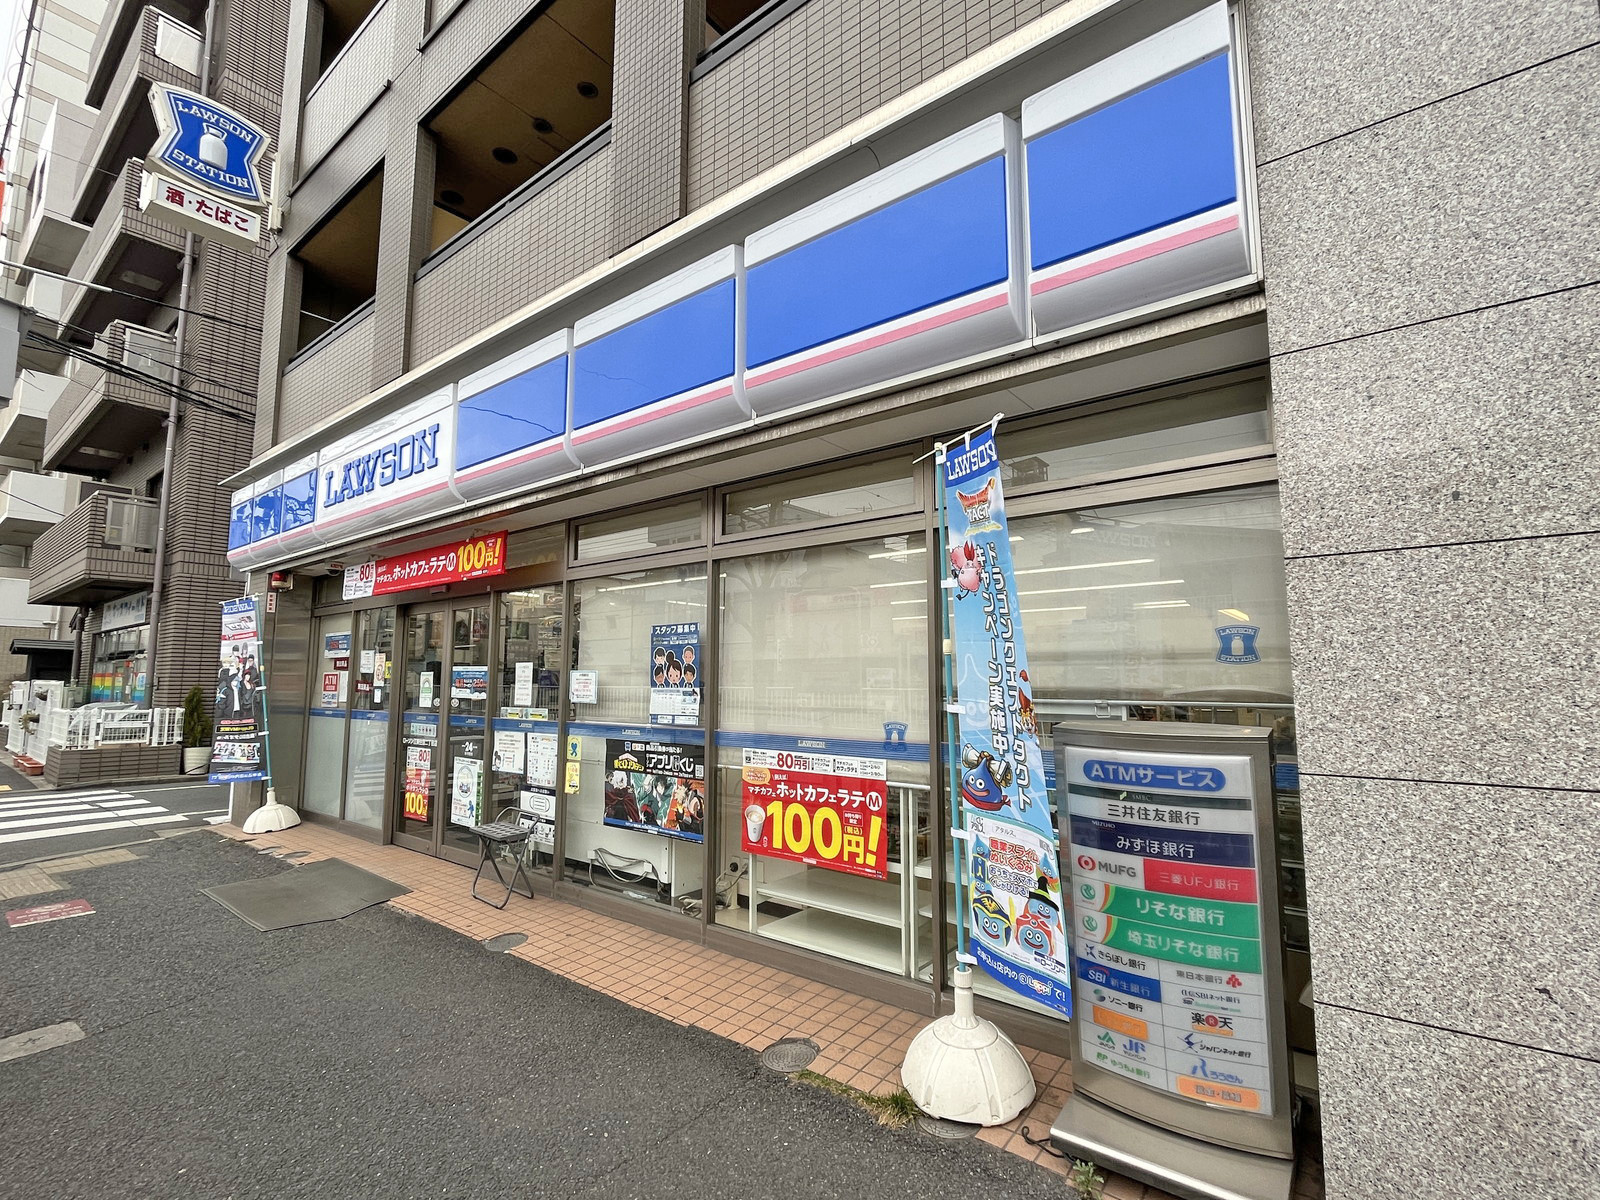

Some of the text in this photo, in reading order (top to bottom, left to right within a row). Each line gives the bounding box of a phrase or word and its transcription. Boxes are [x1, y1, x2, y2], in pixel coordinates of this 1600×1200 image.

[176, 101, 253, 143] LAWSON
[172, 149, 250, 188] STATION
[166, 186, 248, 232] 酒・たばこ
[323, 423, 440, 508] LAWSON
[946, 439, 998, 481] LAWSON
[655, 625, 696, 635] スタッフ募集中
[797, 739, 826, 748] LAWSON
[777, 752, 810, 771] 80円引
[1090, 763, 1217, 789] ATMサービス
[1107, 803, 1201, 826] 三井住友銀行
[766, 800, 882, 867] 100円!
[1116, 834, 1195, 859] みずほ銀行
[989, 851, 1034, 874] ぬいぐるみ
[1098, 860, 1137, 878] MUFG
[1159, 872, 1240, 891] 三菱UFJ銀行
[1136, 897, 1225, 927] りそな銀行
[1127, 929, 1240, 963] 埼玉りそな銀行
[1097, 949, 1146, 971] きらぼし銀行
[1087, 969, 1150, 997] SBI 新生銀行
[1176, 970, 1223, 985] 東日本銀行
[1108, 995, 1143, 1012] ソニー銀行
[1199, 1044, 1252, 1059] ジャパンネット銀行
[1110, 1058, 1151, 1079] ゆうちょ銀行
[1210, 1070, 1244, 1085] ろうきん
